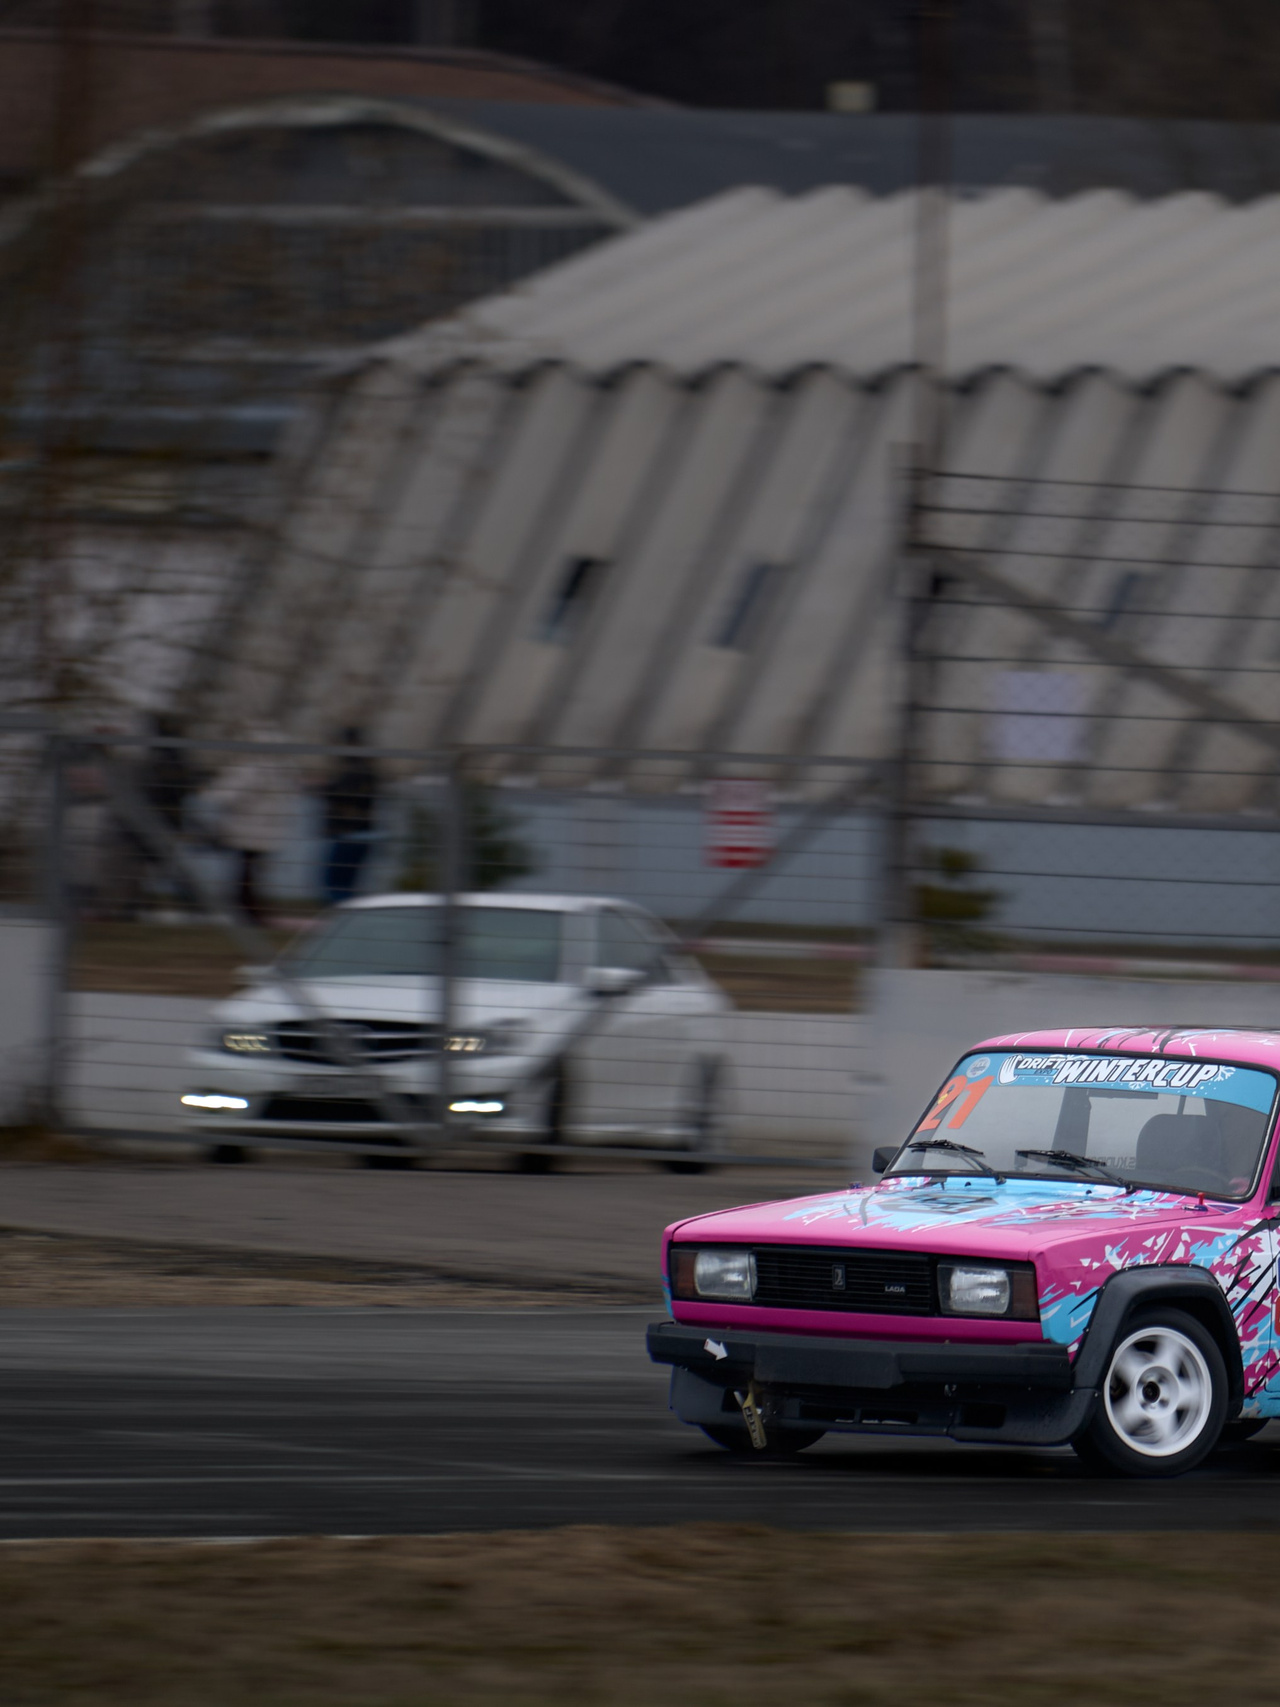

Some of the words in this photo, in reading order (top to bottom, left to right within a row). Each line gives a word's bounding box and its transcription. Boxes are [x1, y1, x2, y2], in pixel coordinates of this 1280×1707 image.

[1018, 1057, 1065, 1070] DRIFT
[915, 1075, 995, 1133] 21
[884, 1285, 906, 1293] LADA
